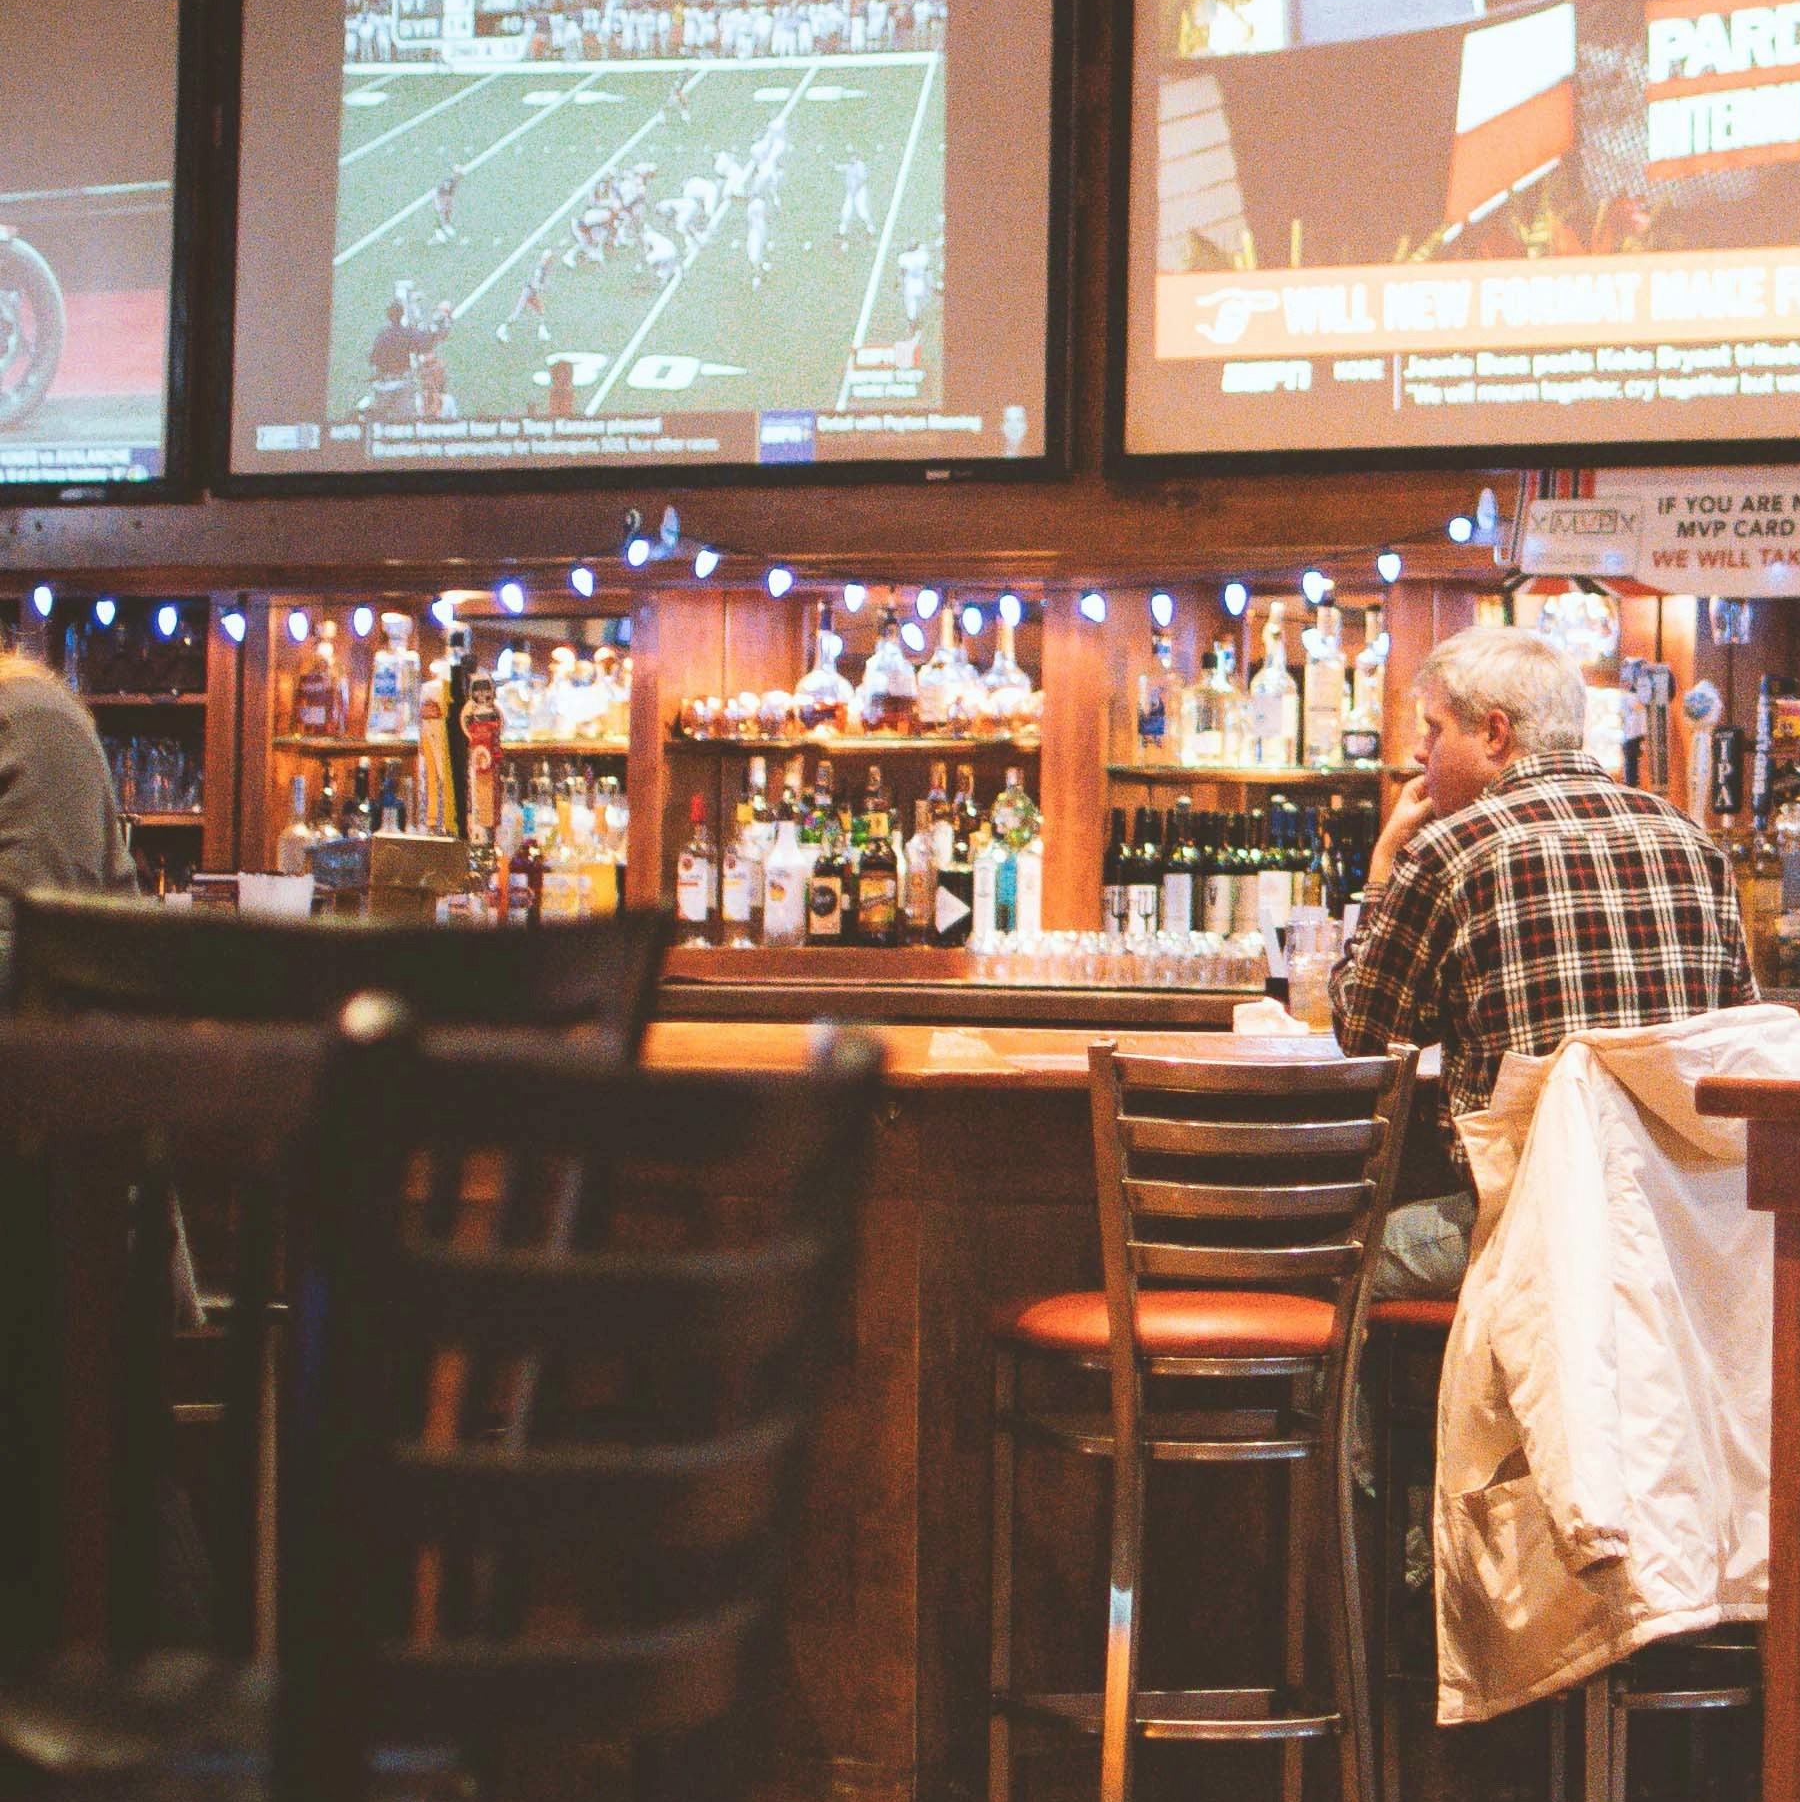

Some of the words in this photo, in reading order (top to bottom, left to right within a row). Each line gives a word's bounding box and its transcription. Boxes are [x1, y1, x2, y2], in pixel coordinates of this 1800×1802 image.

[1281, 282, 1377, 336] WILL
[1382, 278, 1473, 332] NEW
[1479, 270, 1643, 329] FORMAT
[1650, 265, 1768, 324] MAKE
[1597, 347, 1654, 372] Kobe
[1656, 344, 1731, 374] Bryant
[1222, 360, 1312, 393] ESPN
[1477, 382, 1539, 403] mourn
[1624, 379, 1656, 403] cry
[883, 414, 928, 434] Peyton
[1657, 499, 1676, 514] IF
[1685, 495, 1736, 514] YOU
[1739, 494, 1785, 513] ARE
[1676, 519, 1728, 538] MVP
[1733, 518, 1797, 537] CARD
[1652, 549, 1688, 569] WE
[1697, 548, 1751, 568] WILL
[1716, 739, 1734, 807] IPA
[1752, 752, 1769, 795] BUD
